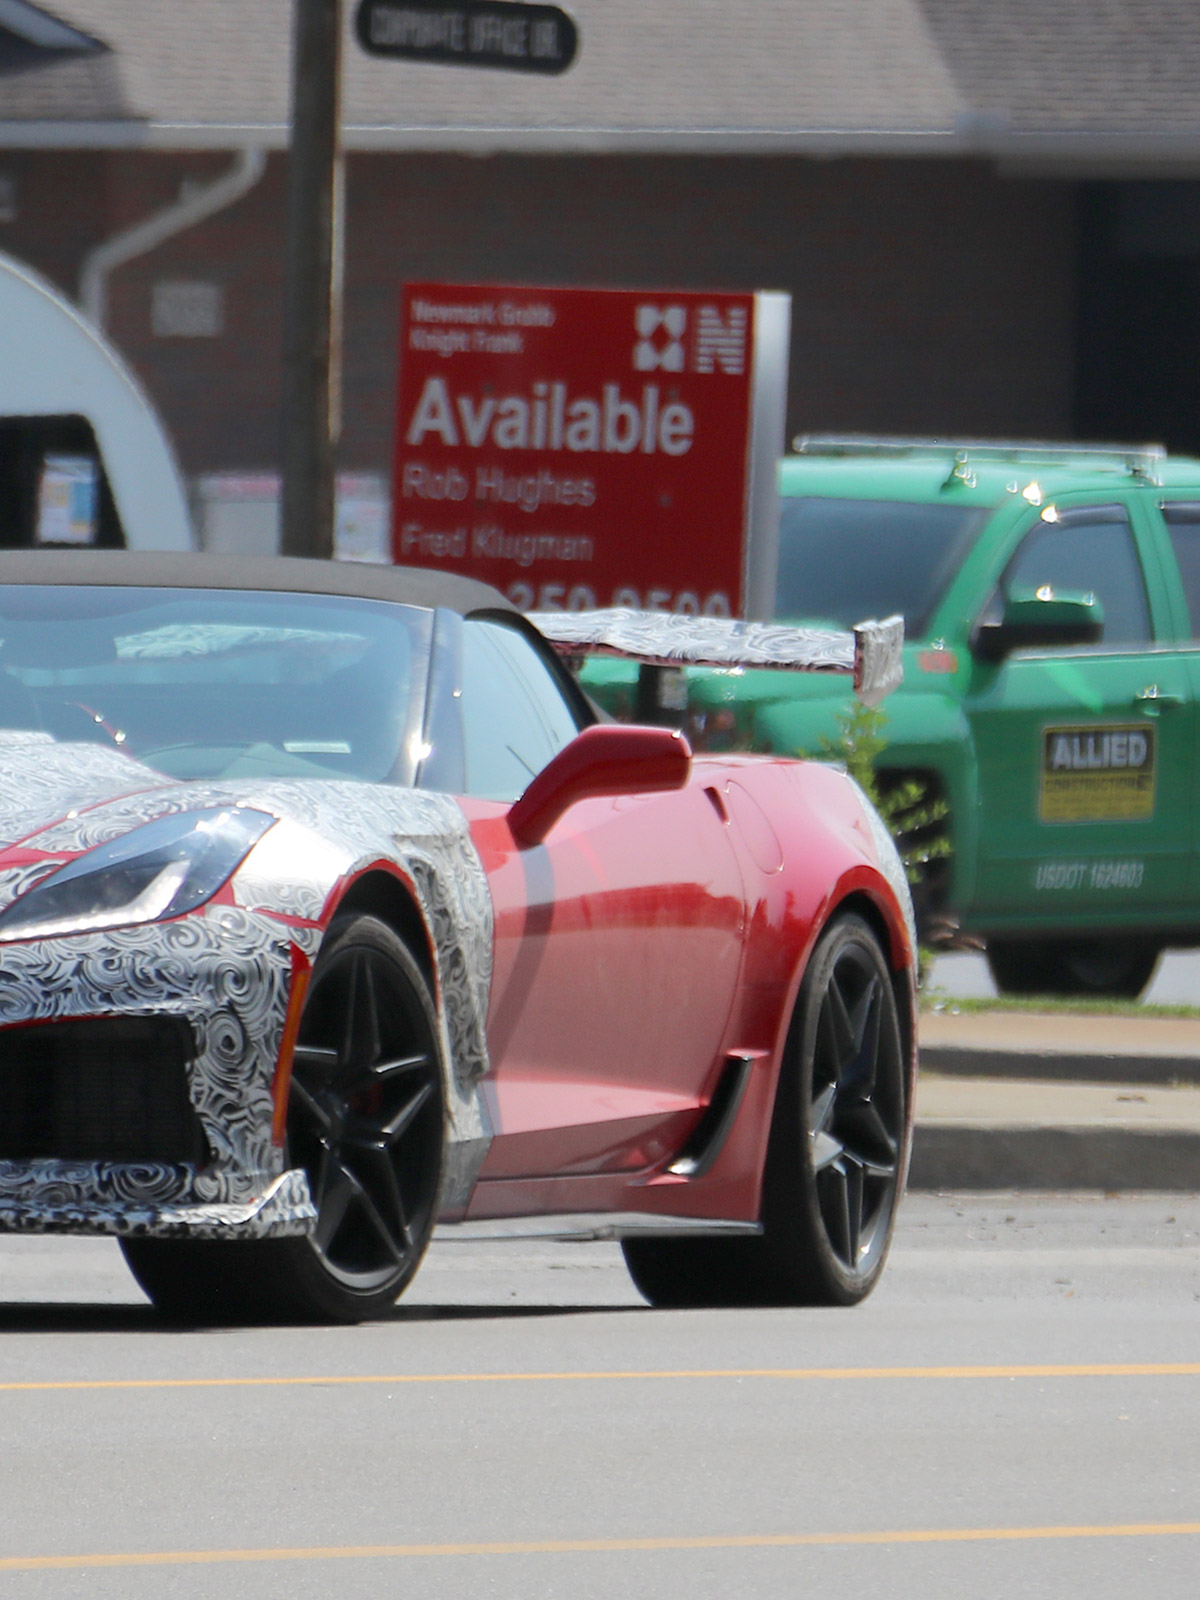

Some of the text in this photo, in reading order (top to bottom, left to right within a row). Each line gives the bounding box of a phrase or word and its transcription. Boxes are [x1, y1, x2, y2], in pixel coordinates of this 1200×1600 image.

[406, 376, 696, 456] Available
[403, 462, 597, 513] Rob Hughes
[402, 523, 595, 567] Fred Klugman
[1052, 731, 1147, 770] ALLIED
[1035, 863, 1087, 890] USDOT
